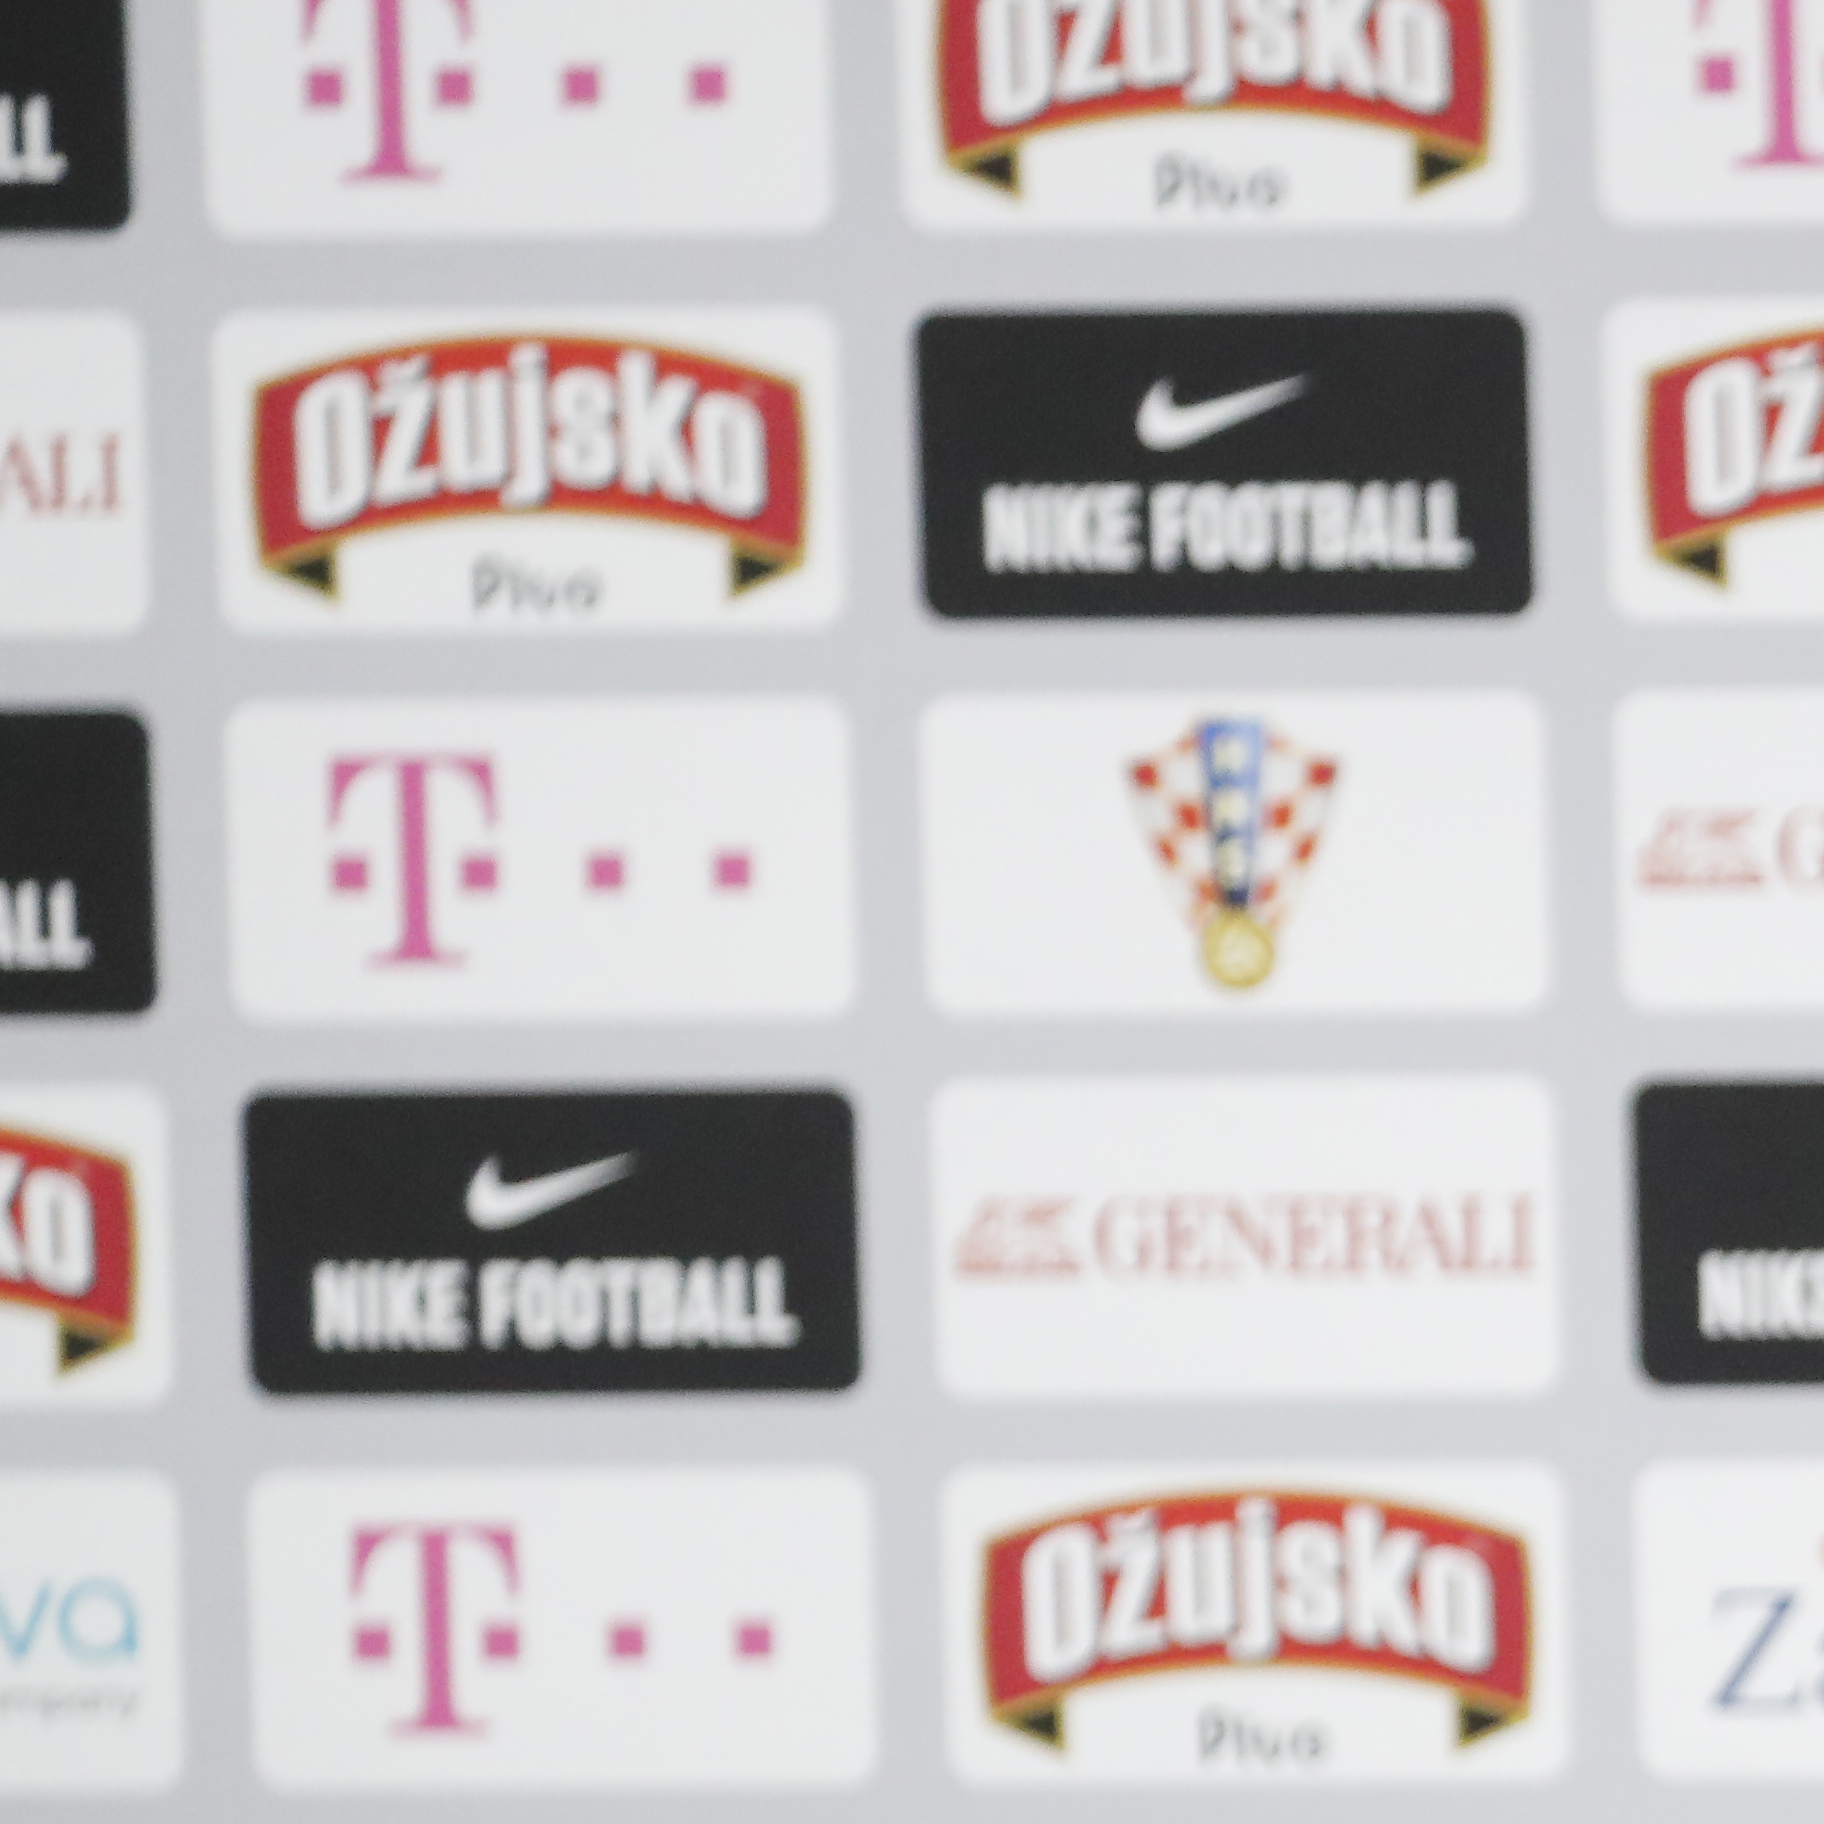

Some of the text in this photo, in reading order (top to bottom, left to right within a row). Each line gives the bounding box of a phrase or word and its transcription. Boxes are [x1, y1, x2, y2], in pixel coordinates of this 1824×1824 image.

[294, 343, 767, 531] Ožujsko
[983, 482, 1474, 573] NIKE FOOTBALL
[1092, 1194, 1535, 1281] GENERALI
[313, 1258, 800, 1349] NIKE FOOTBALL
[1021, 1497, 1496, 1685] Ožujsko
